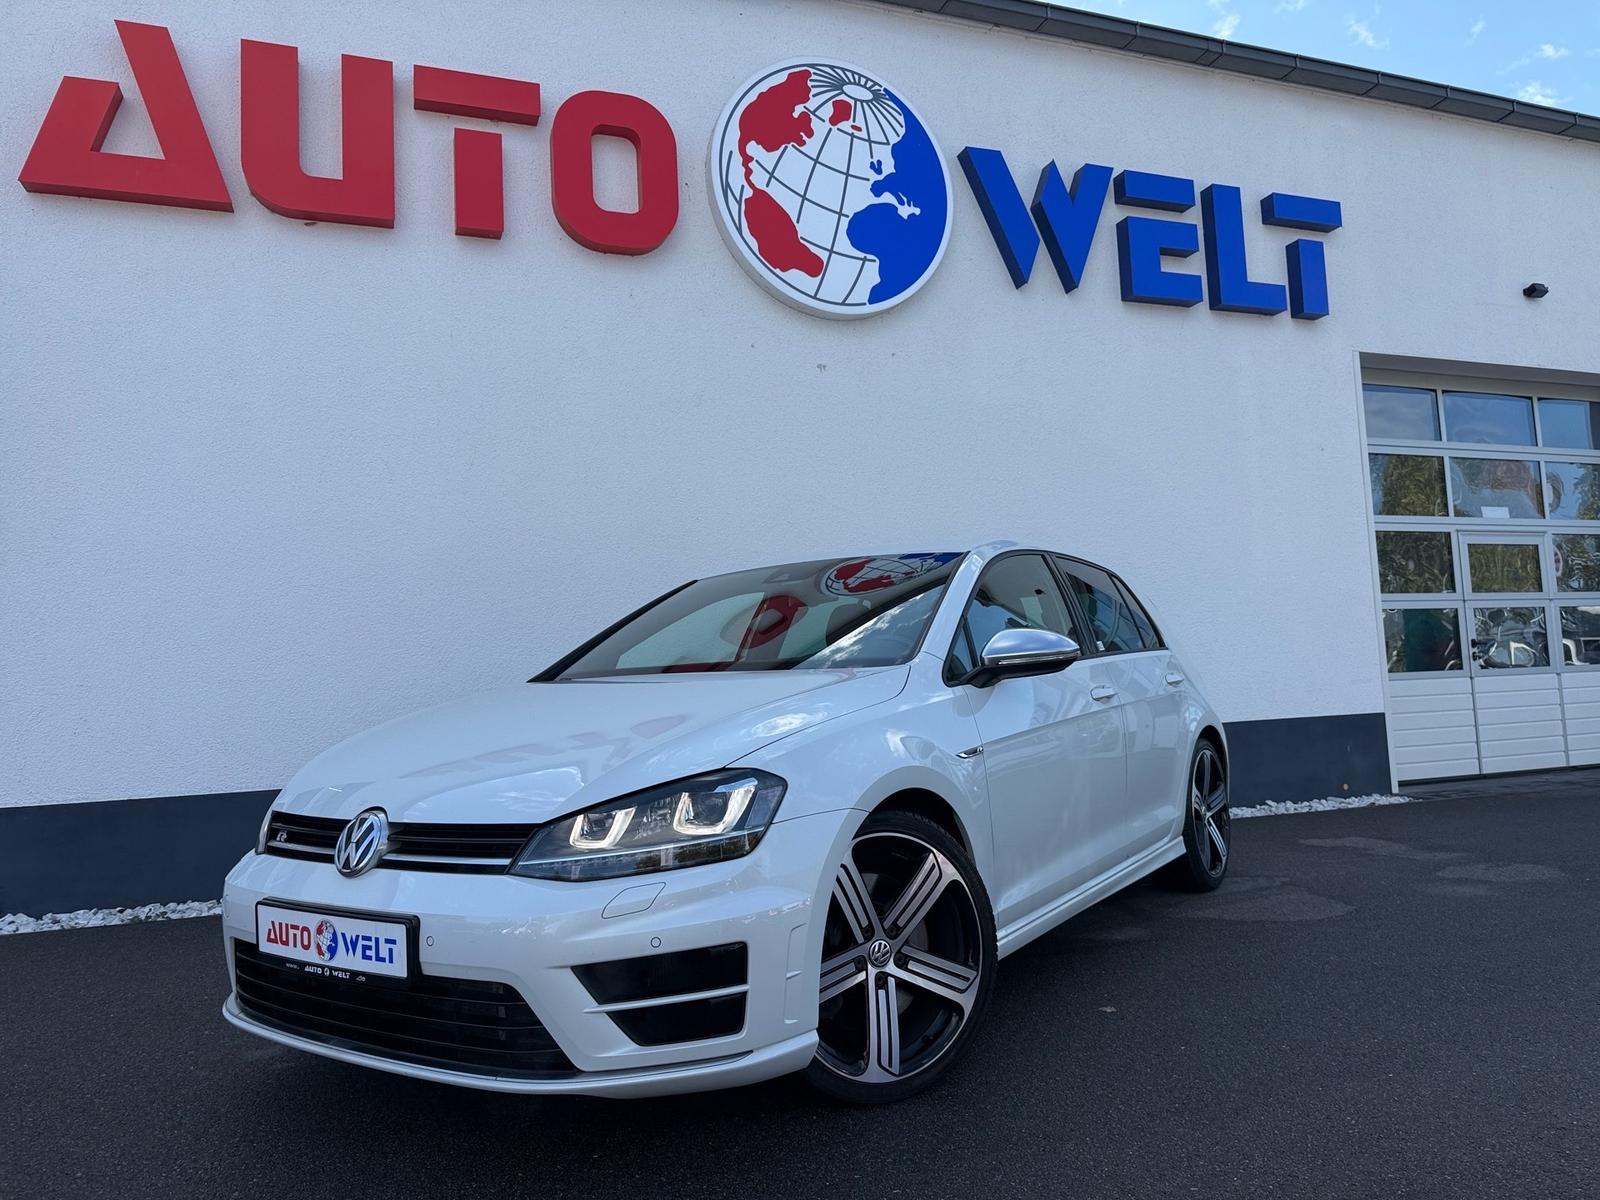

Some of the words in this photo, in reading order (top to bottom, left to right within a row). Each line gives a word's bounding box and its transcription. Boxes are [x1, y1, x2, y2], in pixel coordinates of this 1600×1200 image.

[20, 20, 680, 255] AUTO
[958, 145, 1344, 319] WELT
[267, 920, 311, 951] AUTO
[341, 932, 398, 964] WELT
[304, 965, 323, 975] AUTO
[332, 970, 351, 979] WELT
